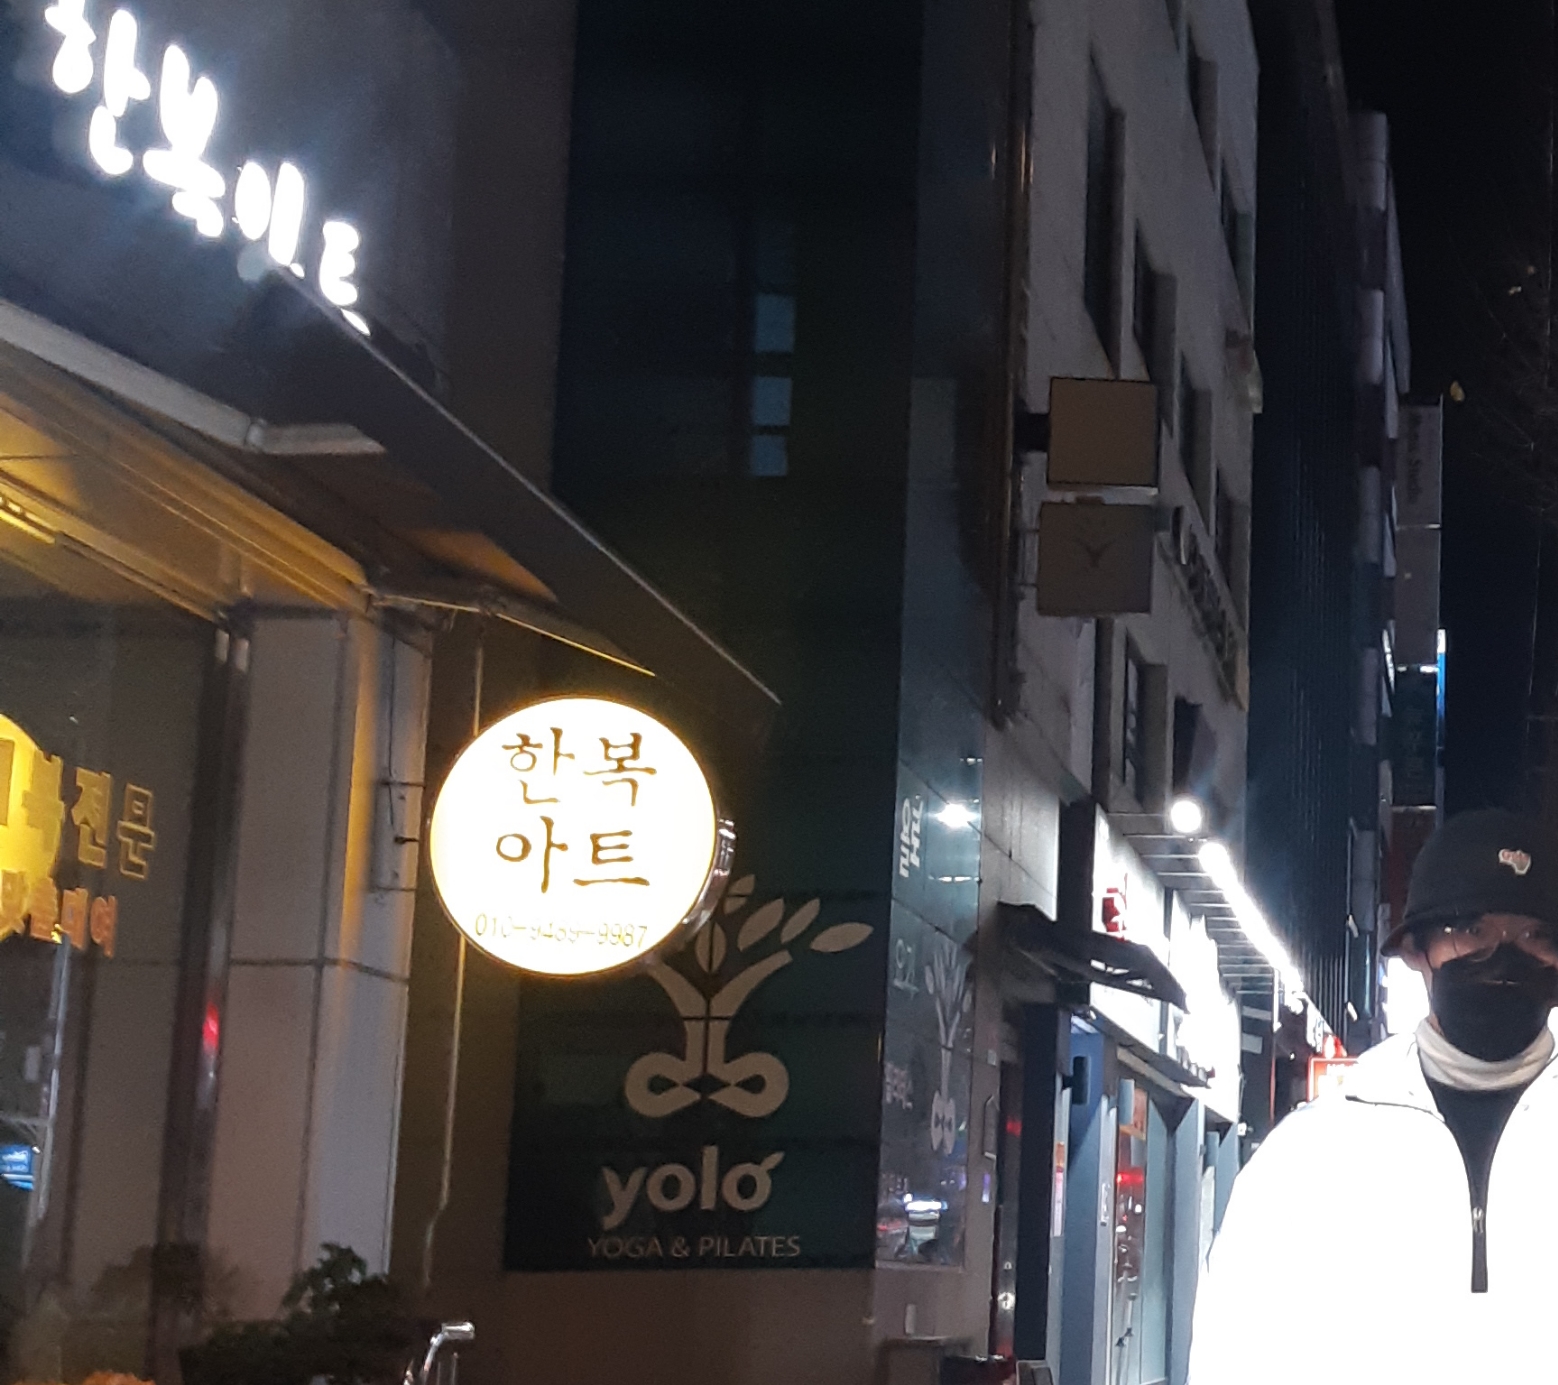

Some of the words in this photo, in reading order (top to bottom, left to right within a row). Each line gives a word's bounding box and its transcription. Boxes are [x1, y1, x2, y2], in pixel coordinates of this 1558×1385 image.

[502, 726, 657, 807] 한복
[496, 815, 650, 894] 아트
[588, 1236, 664, 1259] YOGA
[670, 1236, 691, 1259] &
[698, 1235, 801, 1258] PILATES
